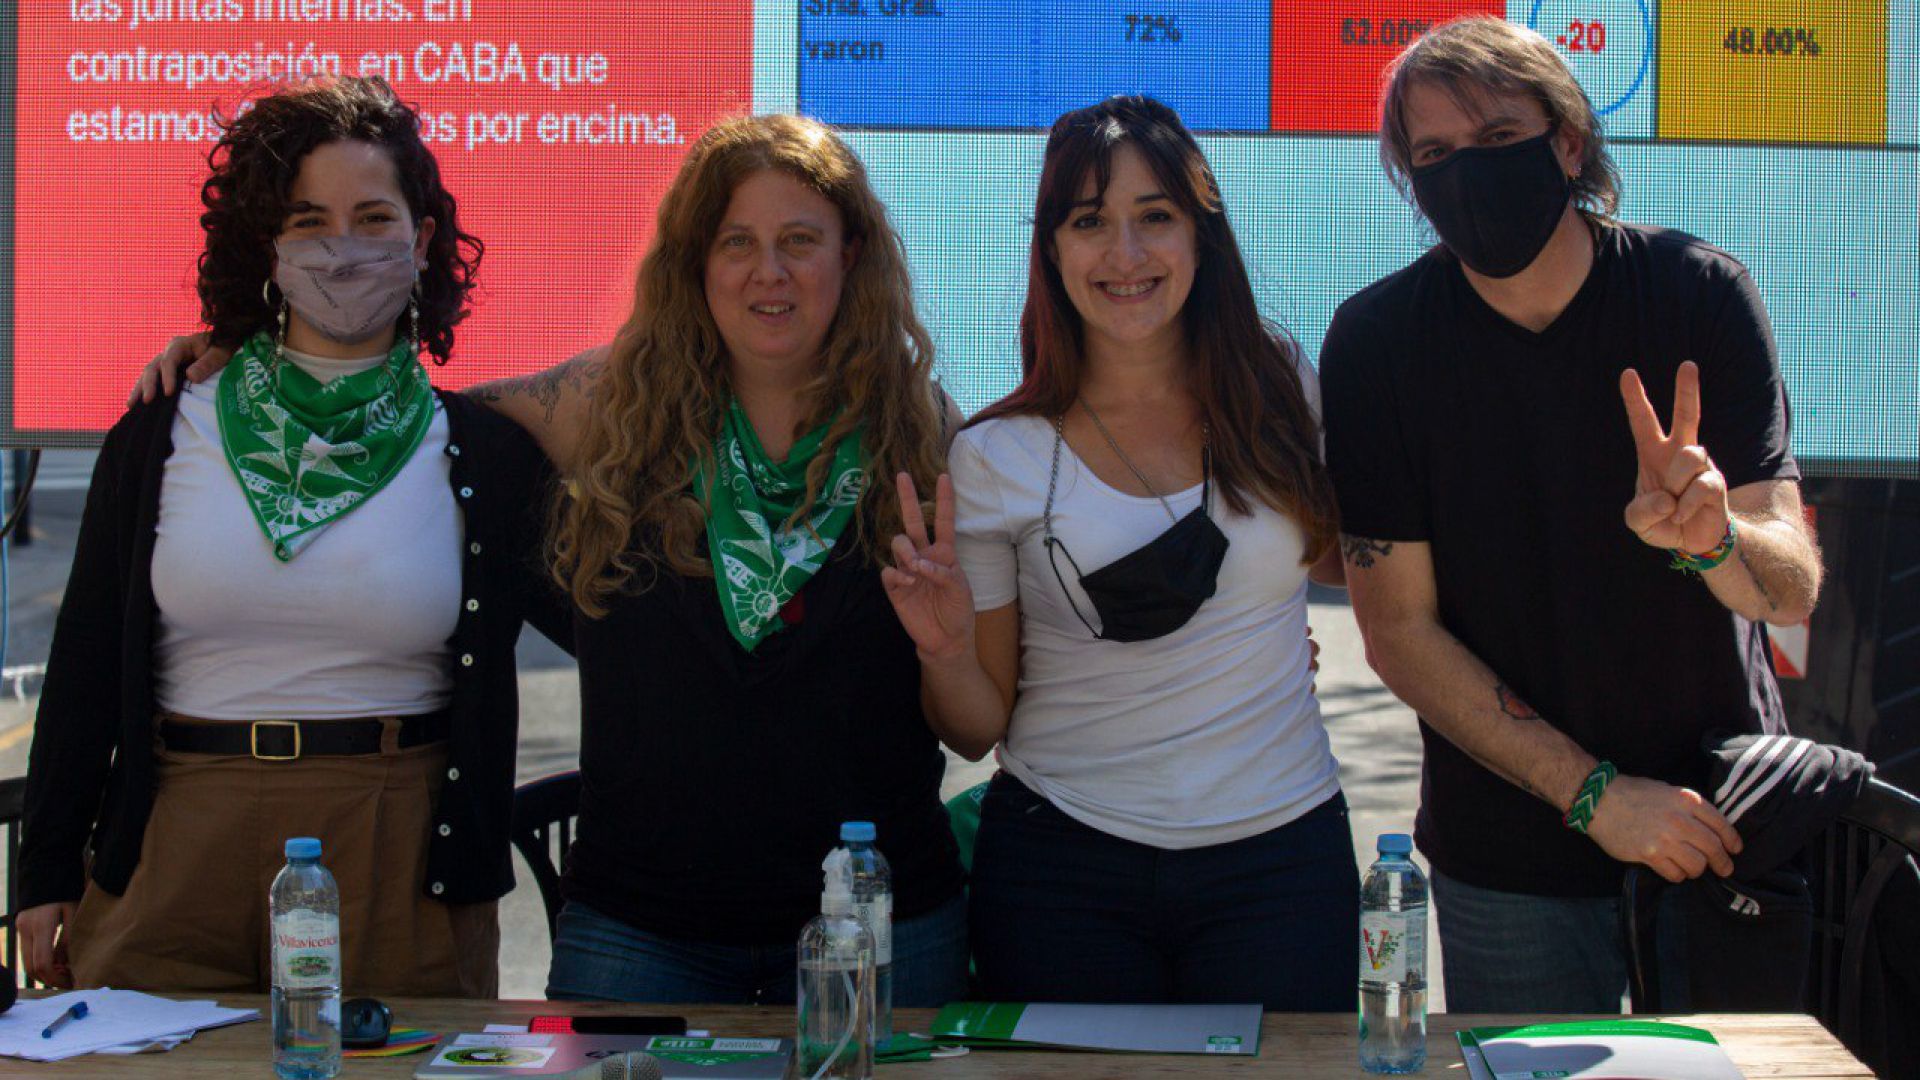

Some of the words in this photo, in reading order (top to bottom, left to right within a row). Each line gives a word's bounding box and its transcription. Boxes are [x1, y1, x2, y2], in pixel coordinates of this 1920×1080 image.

[129, 0, 244, 31] juntas
[254, 0, 413, 22] internas.
[1124, 14, 1182, 42] 72%
[804, 39, 884, 61] varon
[1557, 19, 1606, 53] -20
[1723, 26, 1823, 56] 48.00%
[67, 41, 341, 90] contraposición
[357, 50, 404, 82] en
[413, 41, 527, 83] CABA
[536, 51, 609, 91] que
[67, 106, 225, 142] estamos
[465, 110, 529, 151] por
[536, 104, 685, 145] encima.
